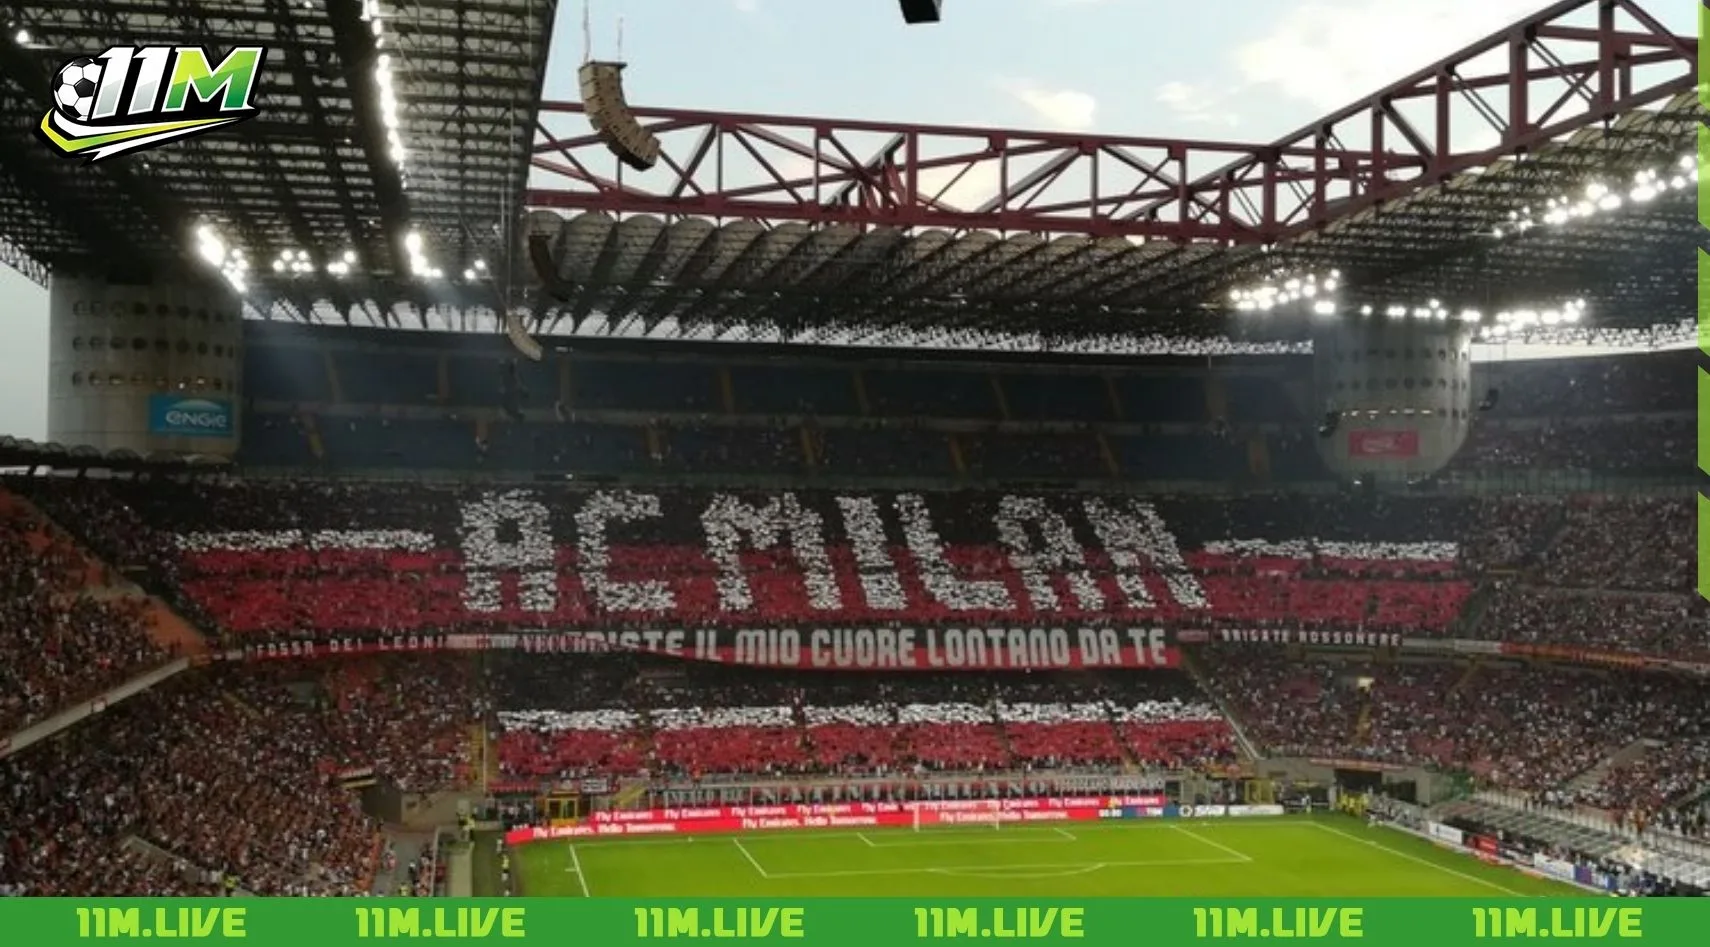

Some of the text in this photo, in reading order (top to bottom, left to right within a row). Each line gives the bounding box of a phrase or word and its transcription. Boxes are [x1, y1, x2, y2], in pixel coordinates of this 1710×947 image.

[458, 489, 1212, 612] AC MILAN
[329, 637, 363, 653] DEI
[378, 635, 443, 650] LEONI
[695, 629, 724, 662] IL
[735, 628, 800, 666] MIO
[811, 628, 917, 668] CUORE
[927, 628, 1070, 667] LONTANO
[1079, 628, 1121, 666] DA
[1127, 628, 1168, 665] TE
